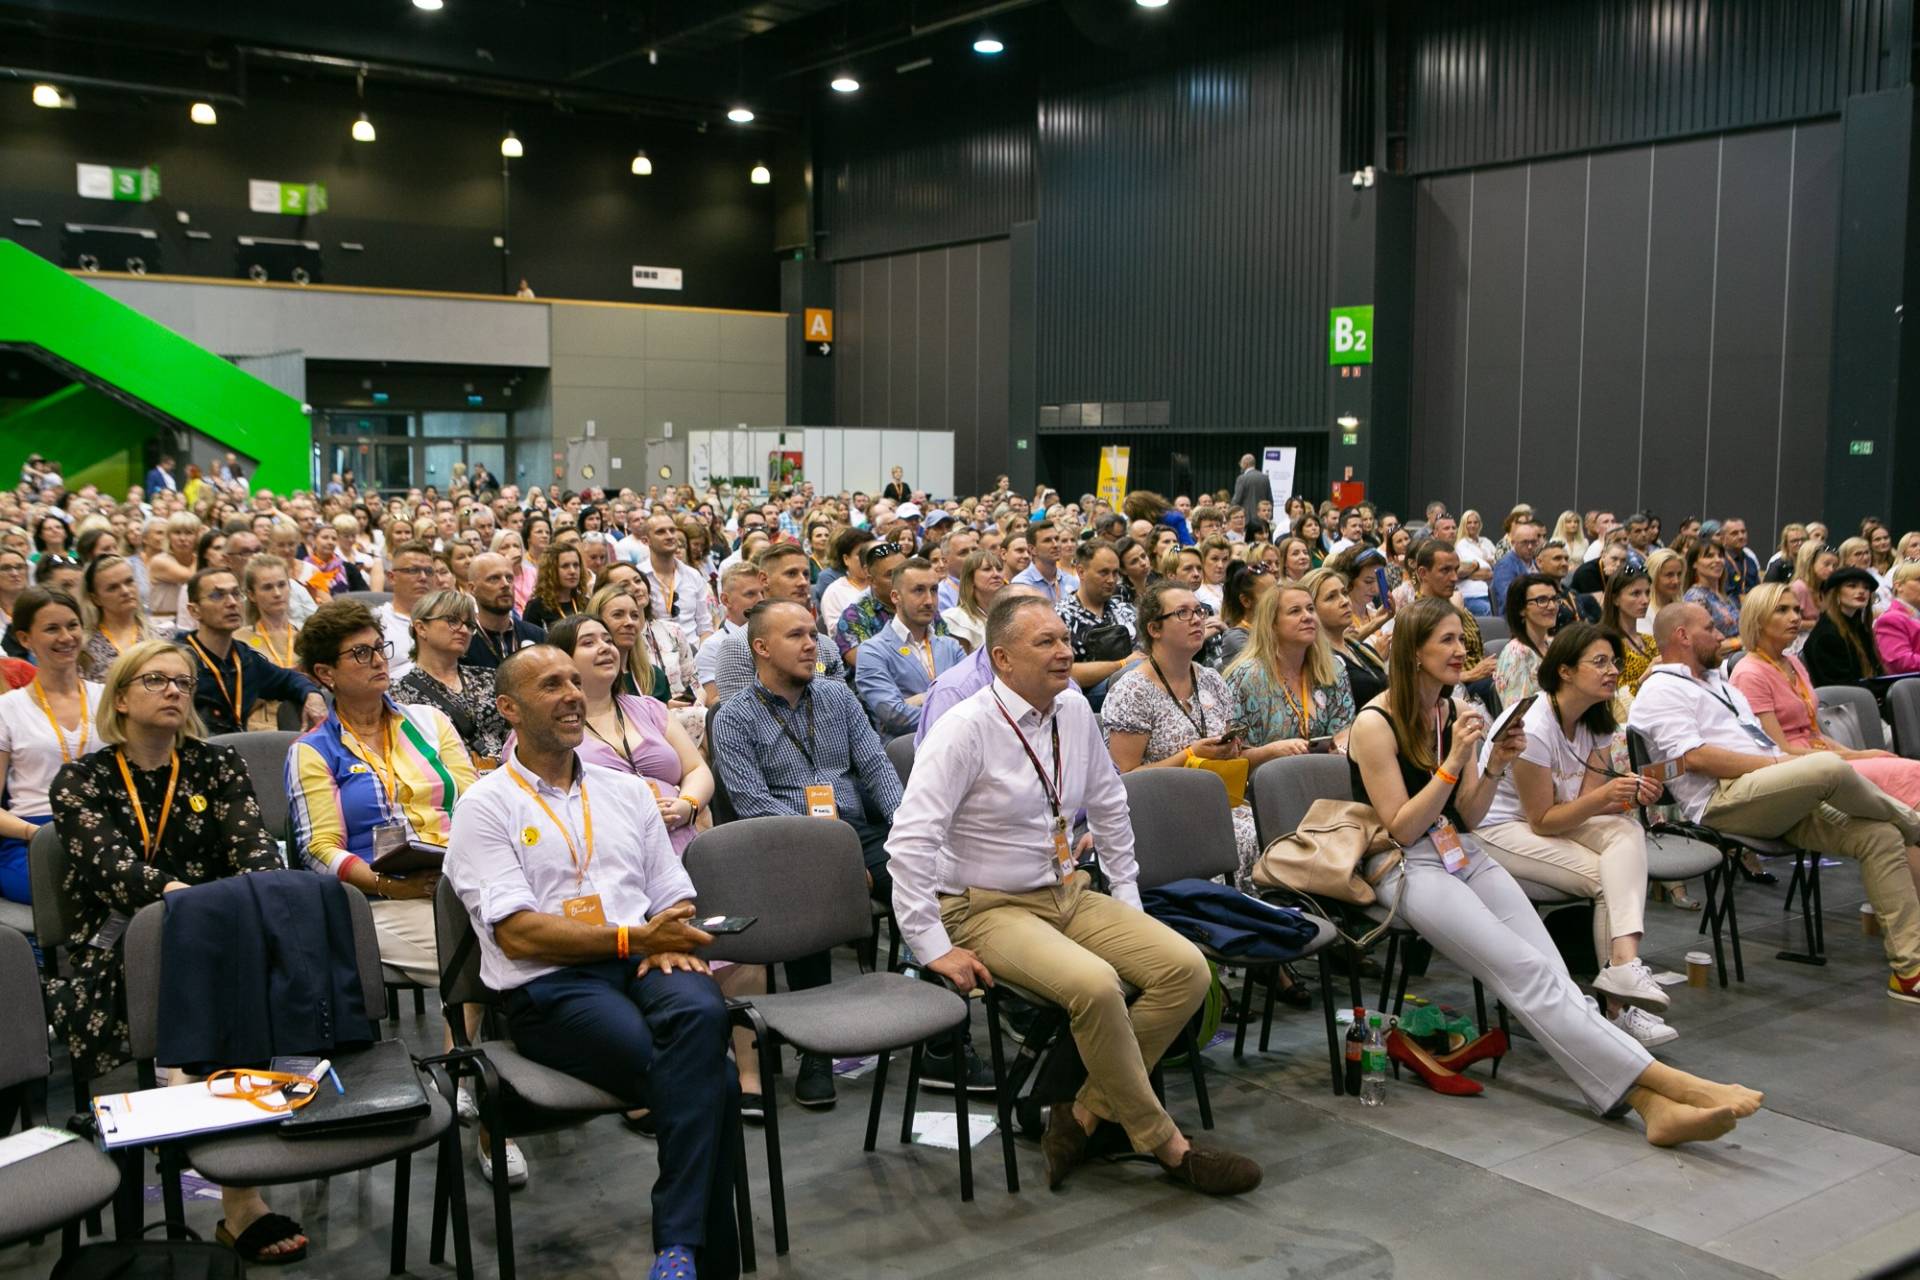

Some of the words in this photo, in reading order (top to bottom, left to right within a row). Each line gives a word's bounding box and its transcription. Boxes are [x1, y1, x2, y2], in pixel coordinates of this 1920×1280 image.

[118, 174, 136, 194] 3
[287, 191, 301, 208] 2
[811, 314, 828, 336] A
[1335, 316, 1366, 352] B2
